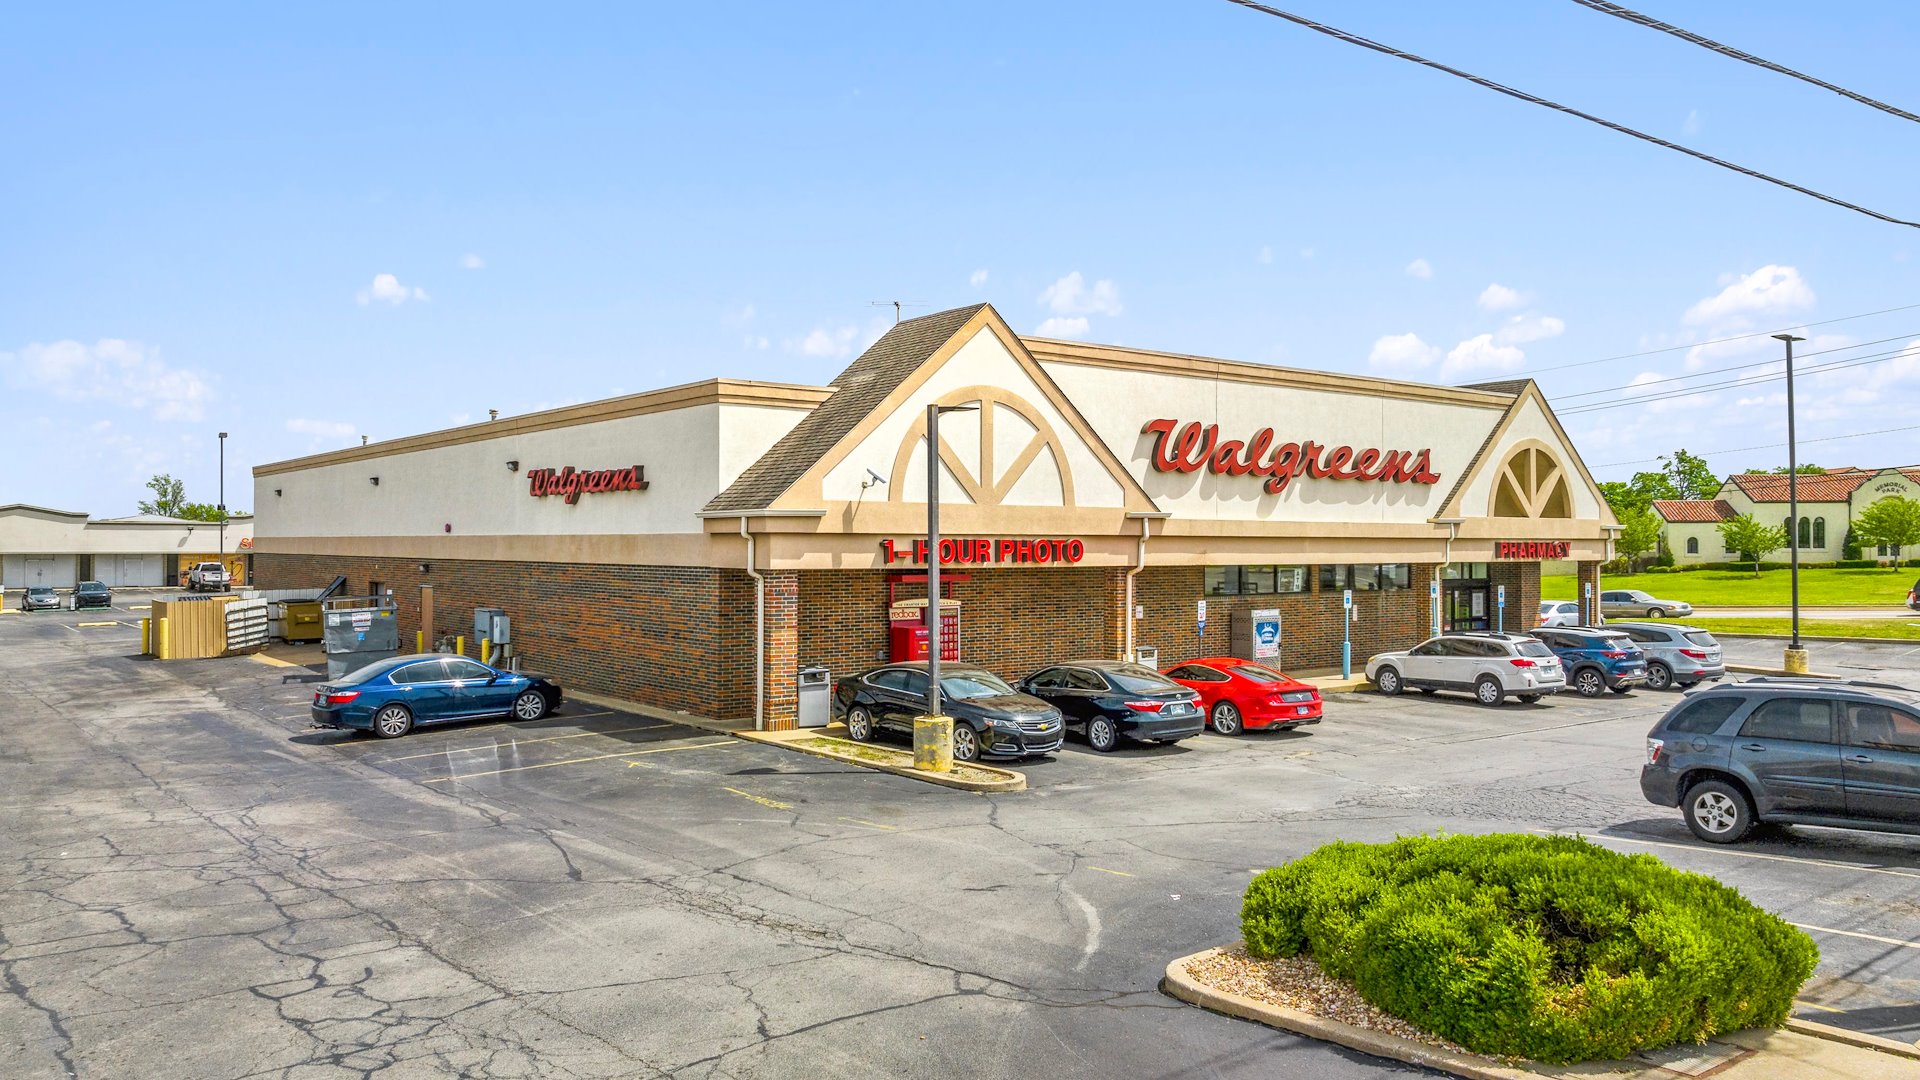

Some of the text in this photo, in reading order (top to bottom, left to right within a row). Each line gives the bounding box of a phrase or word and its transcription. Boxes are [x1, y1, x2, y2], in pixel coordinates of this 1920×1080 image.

[1141, 418, 1441, 495] Walgreens
[527, 465, 650, 505] Walgreens
[1875, 482, 1907, 492] MEMORIAL
[995, 538, 1084, 564] PHOTO
[1495, 541, 1571, 559] PHARMACY
